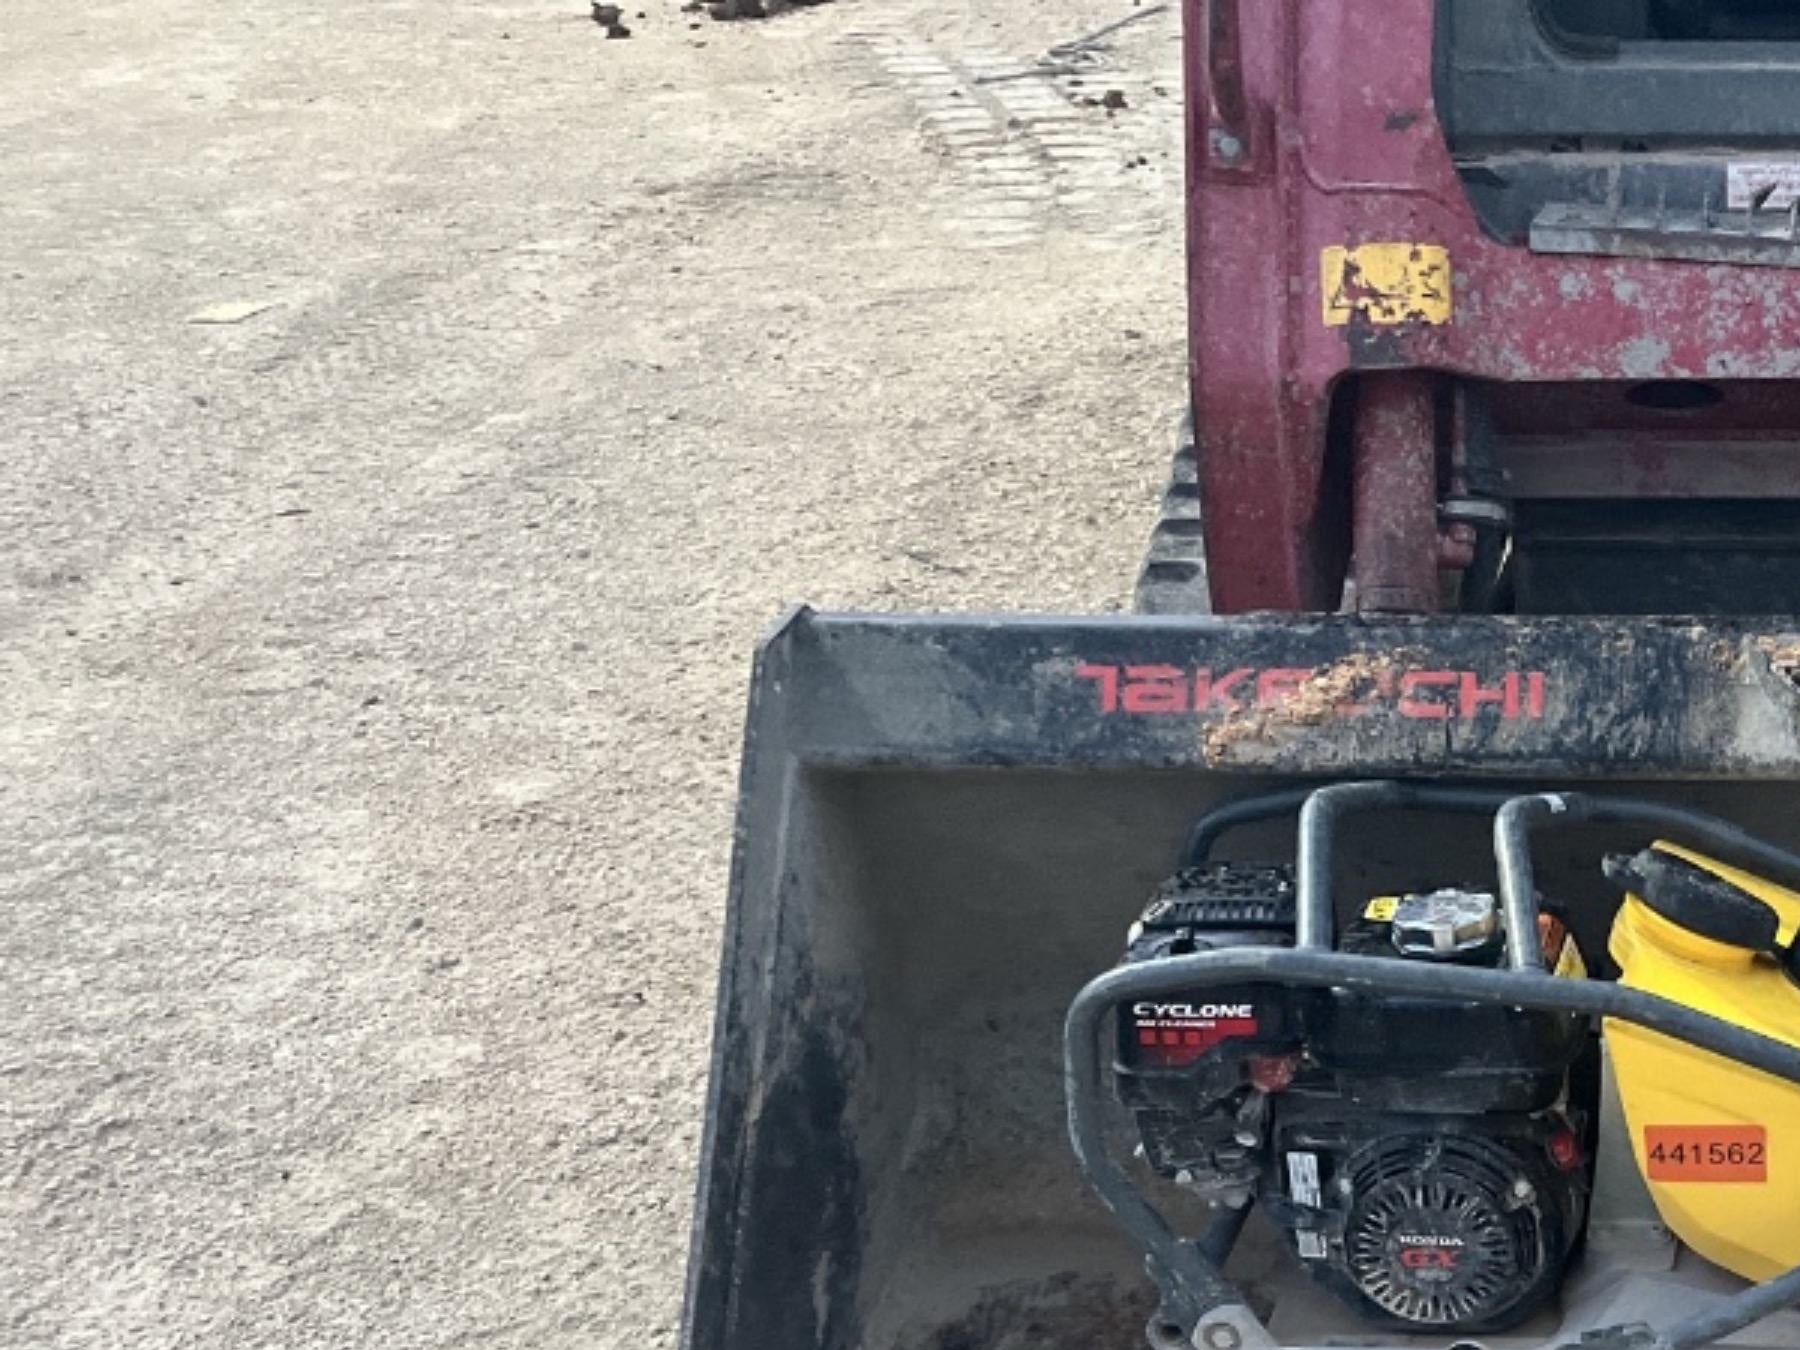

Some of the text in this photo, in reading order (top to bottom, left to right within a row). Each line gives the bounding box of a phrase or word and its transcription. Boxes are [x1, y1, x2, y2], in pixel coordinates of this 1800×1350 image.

[1133, 1002, 1253, 1018] CYCLONE
[1649, 1141, 1765, 1165] 441562
[1400, 1235, 1465, 1247] HONDA
[1402, 1248, 1459, 1268] GX
